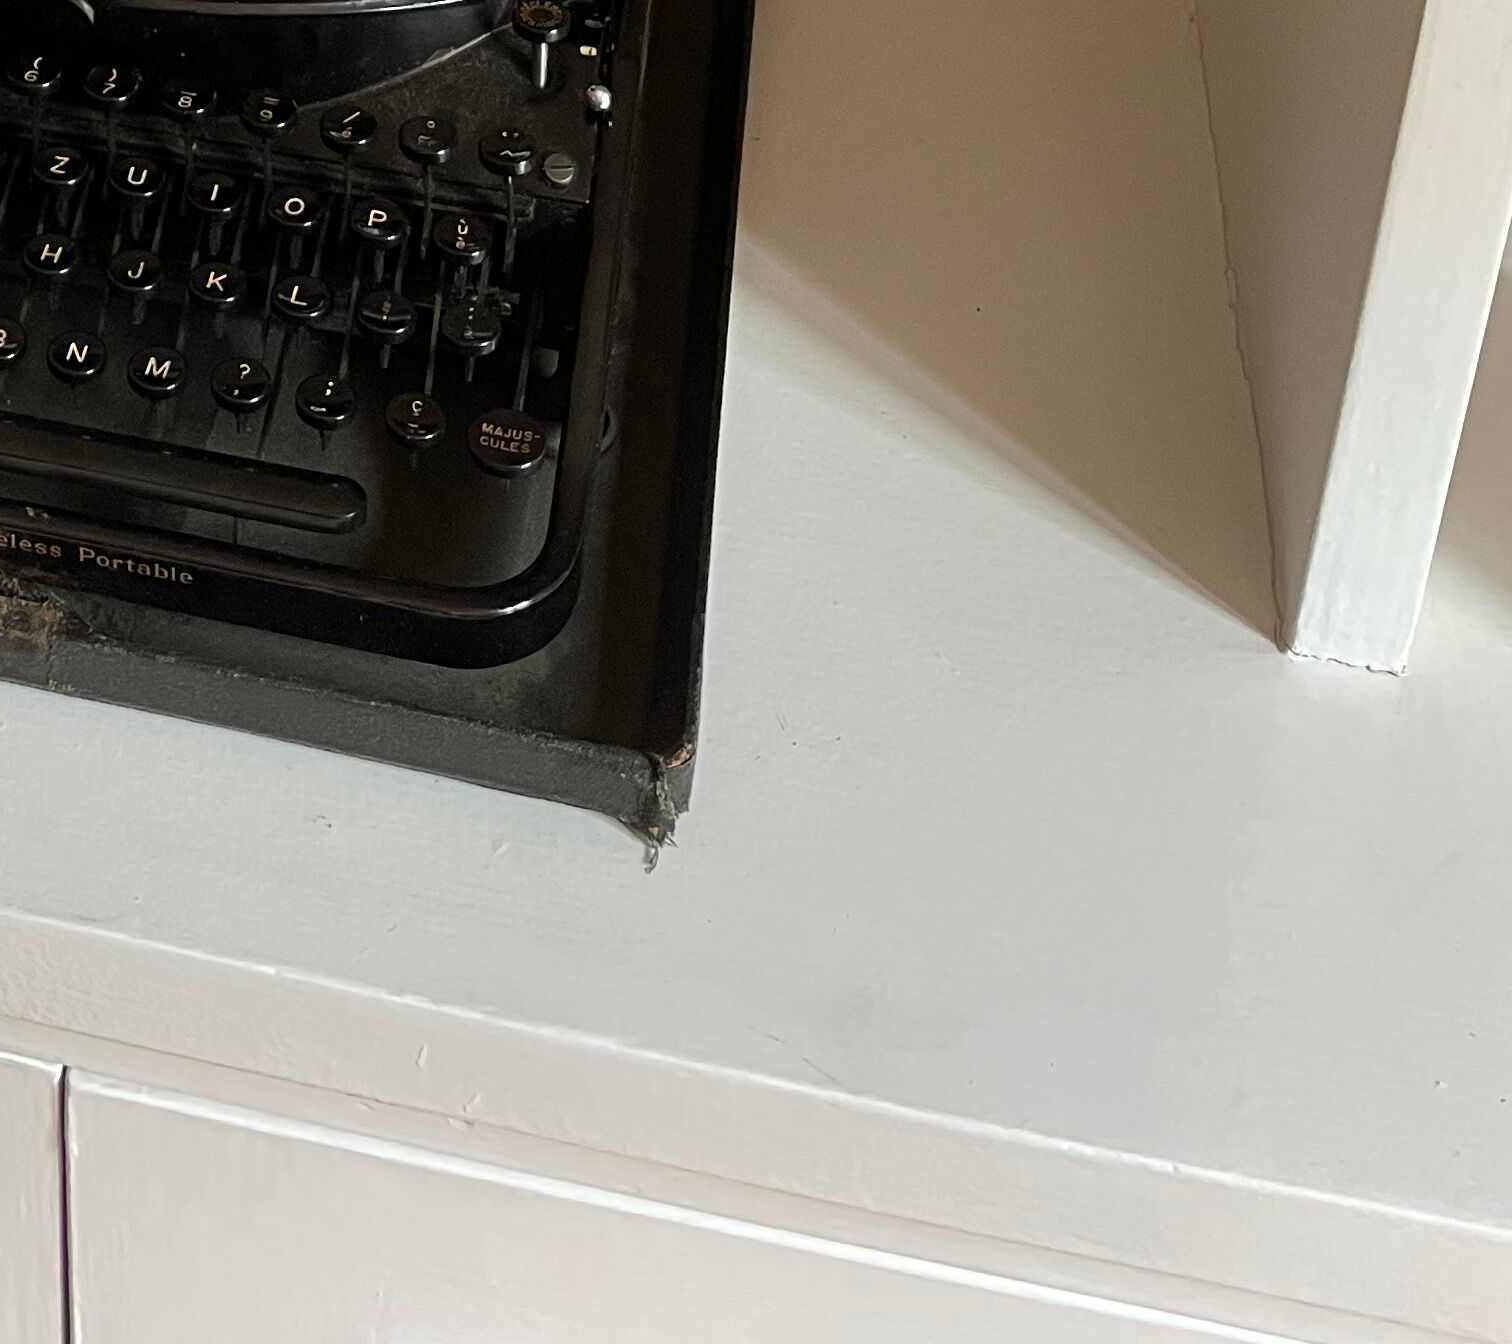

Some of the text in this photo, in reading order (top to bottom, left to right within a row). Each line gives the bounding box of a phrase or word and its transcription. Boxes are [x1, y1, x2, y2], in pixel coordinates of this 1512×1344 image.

[23, 70, 40, 83] 6
[176, 96, 193, 108] 8
[256, 108, 274, 121] 9
[49, 155, 71, 175] Z
[127, 166, 148, 185] U
[283, 197, 306, 216] O
[367, 209, 388, 227] P
[40, 243, 64, 264] H
[127, 261, 145, 280] J
[205, 270, 228, 293] K
[289, 285, 309, 306] L
[65, 341, 90, 364] N
[144, 356, 172, 380] M
[482, 422, 541, 442] MAJUS-
[479, 435, 530, 454] CULES
[79, 547, 194, 586] Portable
